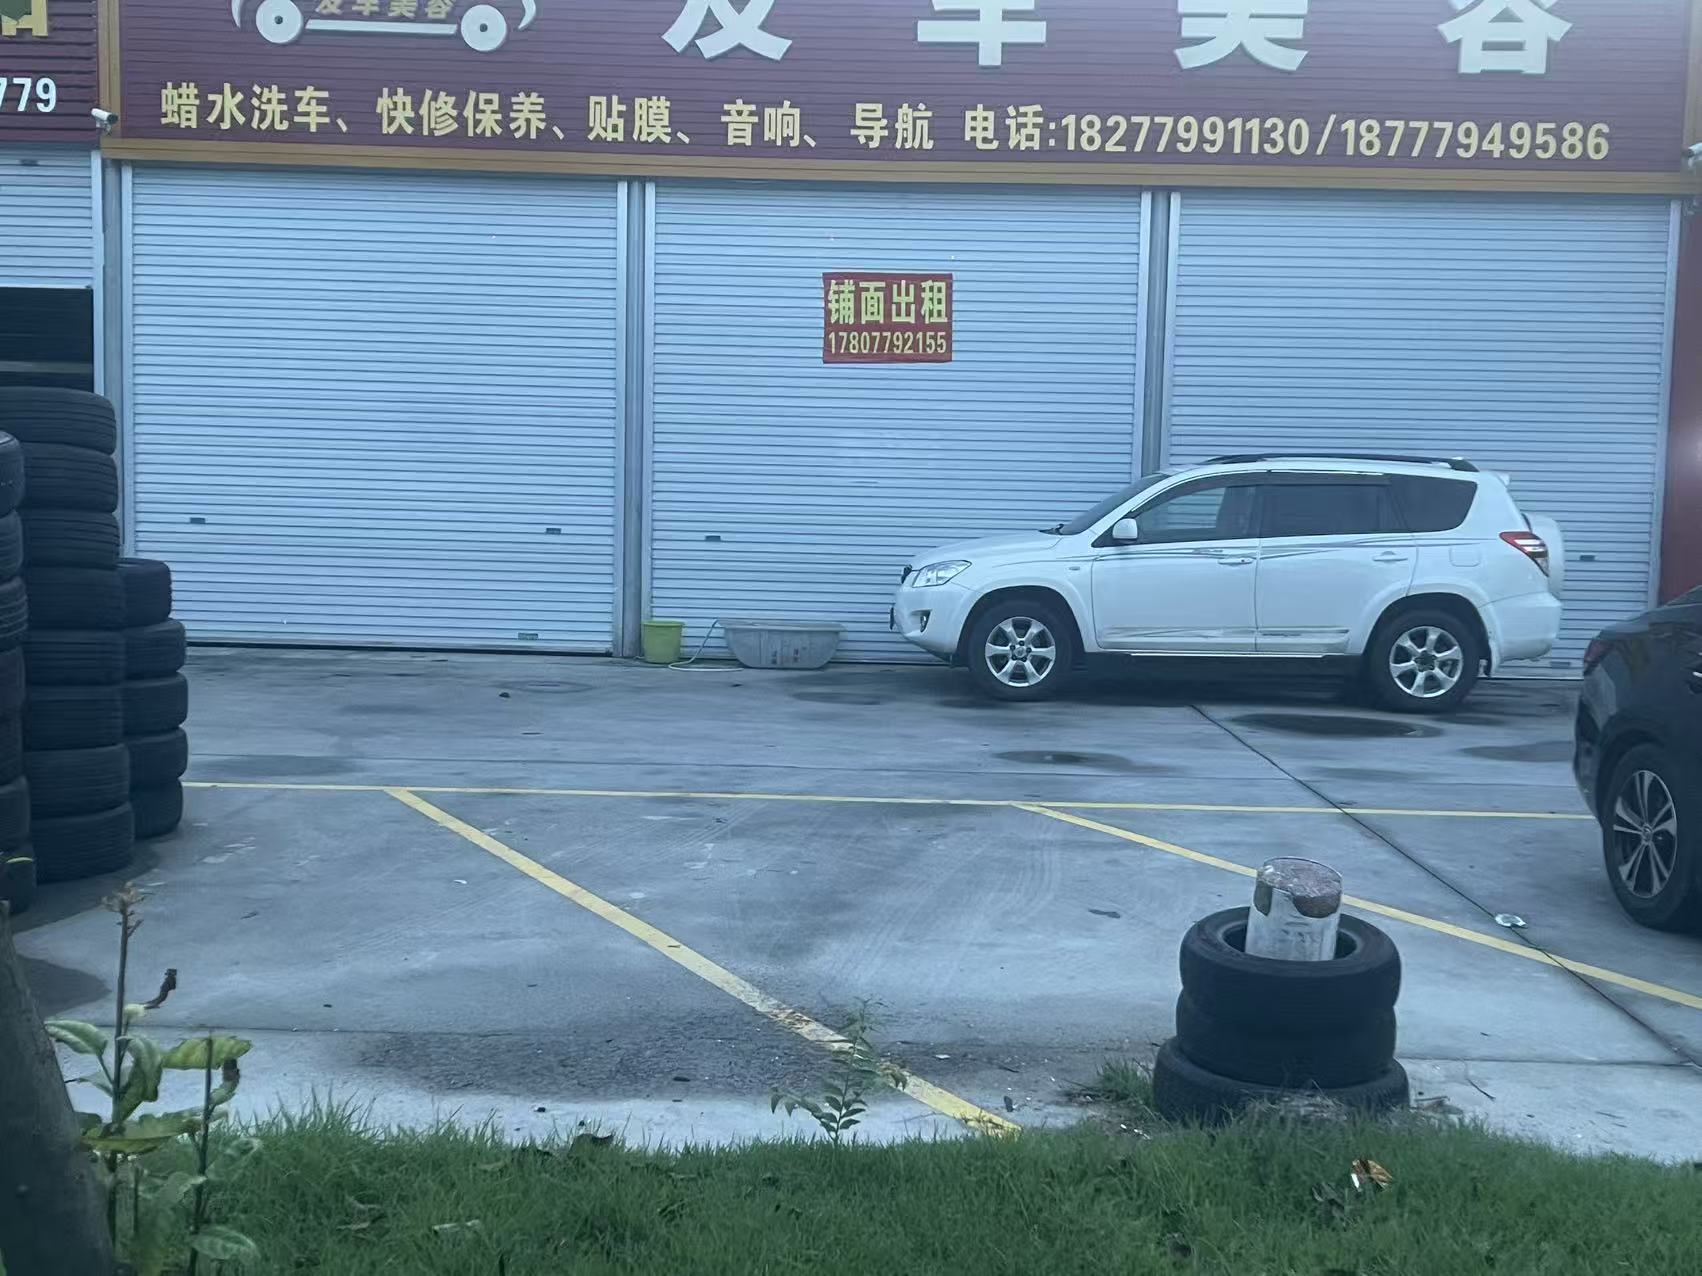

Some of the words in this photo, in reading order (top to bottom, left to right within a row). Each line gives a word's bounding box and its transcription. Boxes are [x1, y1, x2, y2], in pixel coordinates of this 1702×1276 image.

[827, 279, 948, 325] 铺面出租
[828, 331, 947, 354] 17807792155
